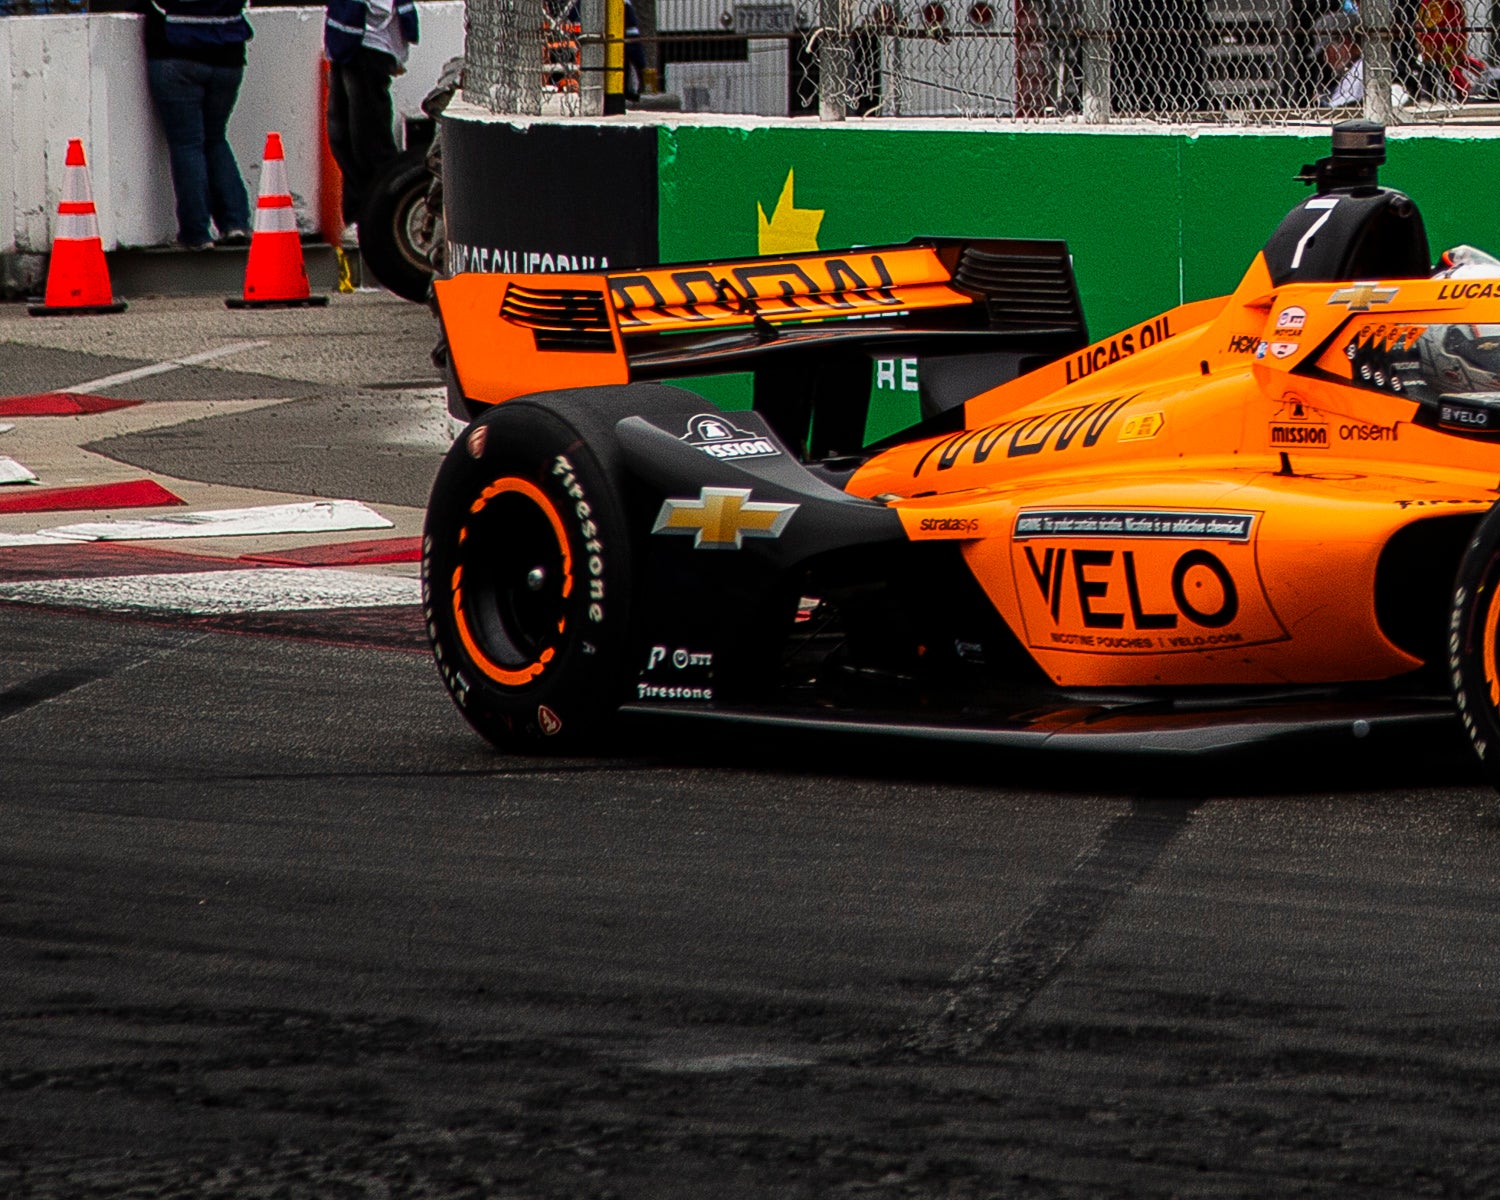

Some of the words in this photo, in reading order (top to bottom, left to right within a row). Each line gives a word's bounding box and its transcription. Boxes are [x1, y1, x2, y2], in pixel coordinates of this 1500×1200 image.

[1290, 199, 1340, 269] 7
[1066, 336, 1136, 385] LUCAS
[1140, 316, 1176, 350] OIL
[1228, 335, 1262, 354] HOK
[1452, 411, 1488, 424] VELO
[919, 519, 979, 536] stratasys
[552, 455, 604, 622] Firestone
[1023, 546, 1239, 630] VELO
[1050, 633, 1095, 646] NICOTINE
[1097, 637, 1153, 648] POUCHES
[637, 683, 713, 699] Firestone
